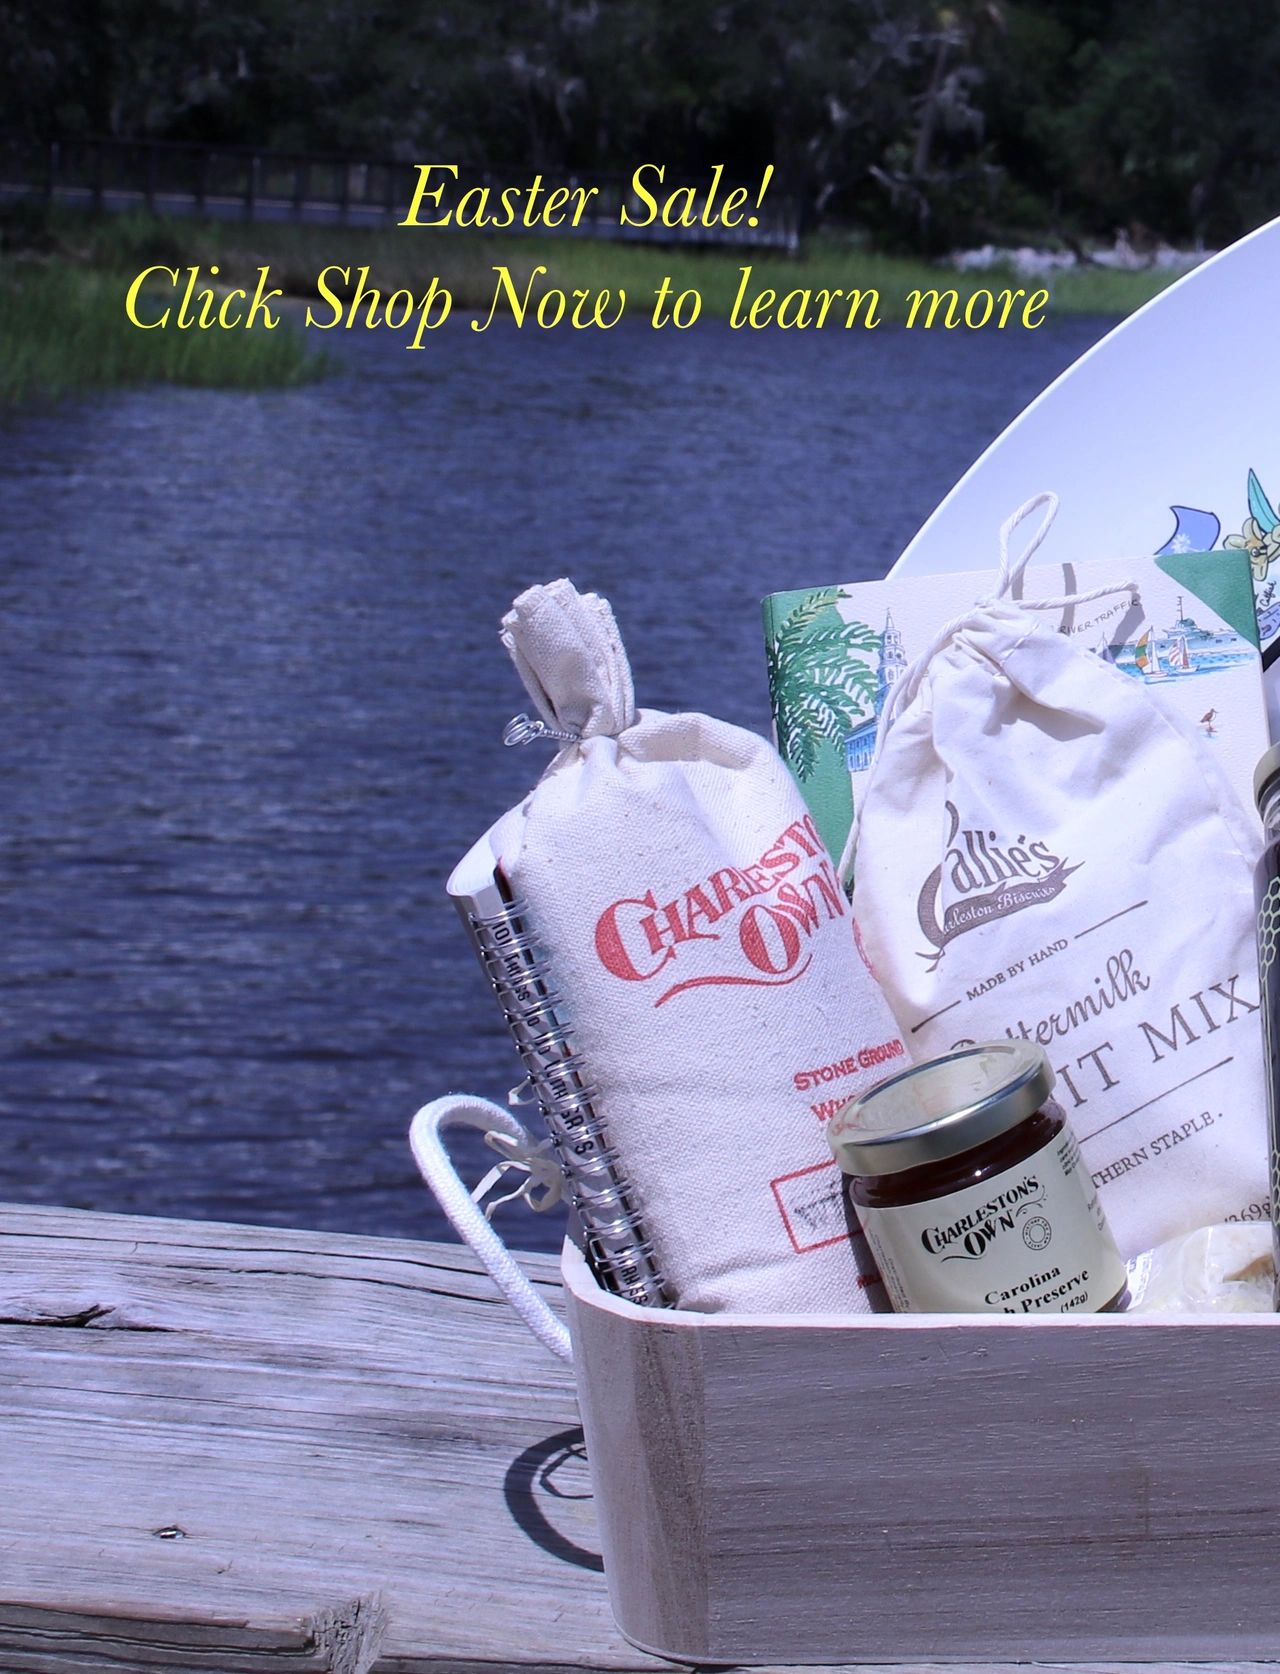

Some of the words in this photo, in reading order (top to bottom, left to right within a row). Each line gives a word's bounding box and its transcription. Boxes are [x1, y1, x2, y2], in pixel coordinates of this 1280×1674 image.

[965, 971, 1007, 1001] MADE
[1008, 959, 1027, 978] BY
[1028, 937, 1070, 965] HAND
[1137, 974, 1261, 1064] MIX
[794, 1057, 858, 1091] STONE
[857, 1039, 904, 1069] GROUND
[963, 1208, 1015, 1257] OWN
[984, 1265, 1061, 1306] Carolina
[1019, 1268, 1090, 1314] Preserve
